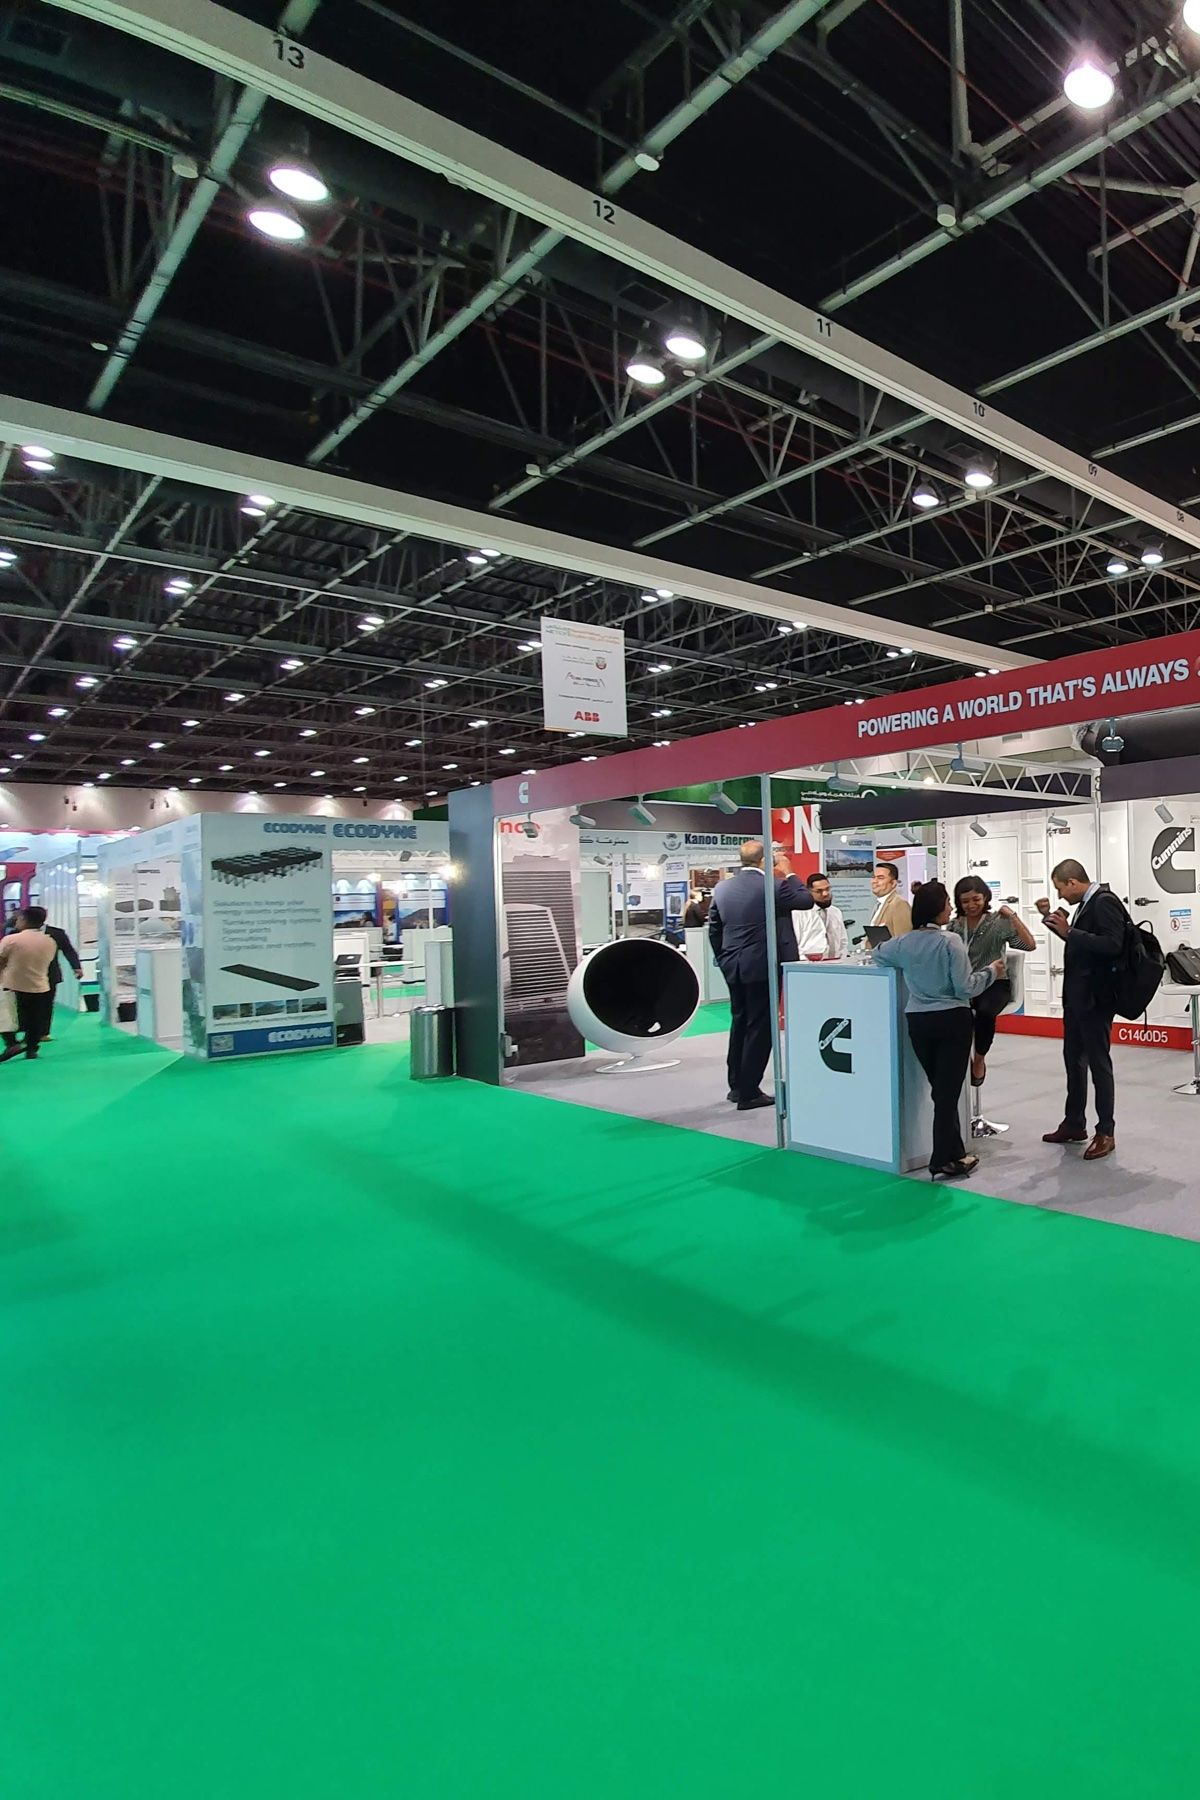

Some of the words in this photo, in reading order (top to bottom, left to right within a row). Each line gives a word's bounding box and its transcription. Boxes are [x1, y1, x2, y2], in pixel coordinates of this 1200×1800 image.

[273, 39, 305, 69] 13
[593, 200, 615, 225] 12
[816, 318, 832, 337] 11
[973, 402, 986, 418] 10
[857, 706, 939, 739] POWERING
[942, 704, 955, 723] A
[957, 690, 1023, 721] WORLD
[1026, 676, 1097, 708] THAT'S
[1101, 657, 1189, 695] ALWAYS
[573, 710, 600, 723] ABB
[263, 822, 327, 835] ECODYNE
[332, 823, 418, 840] ECODYNE
[684, 833, 718, 845] Kanoo
[1151, 827, 1193, 870] Cummins
